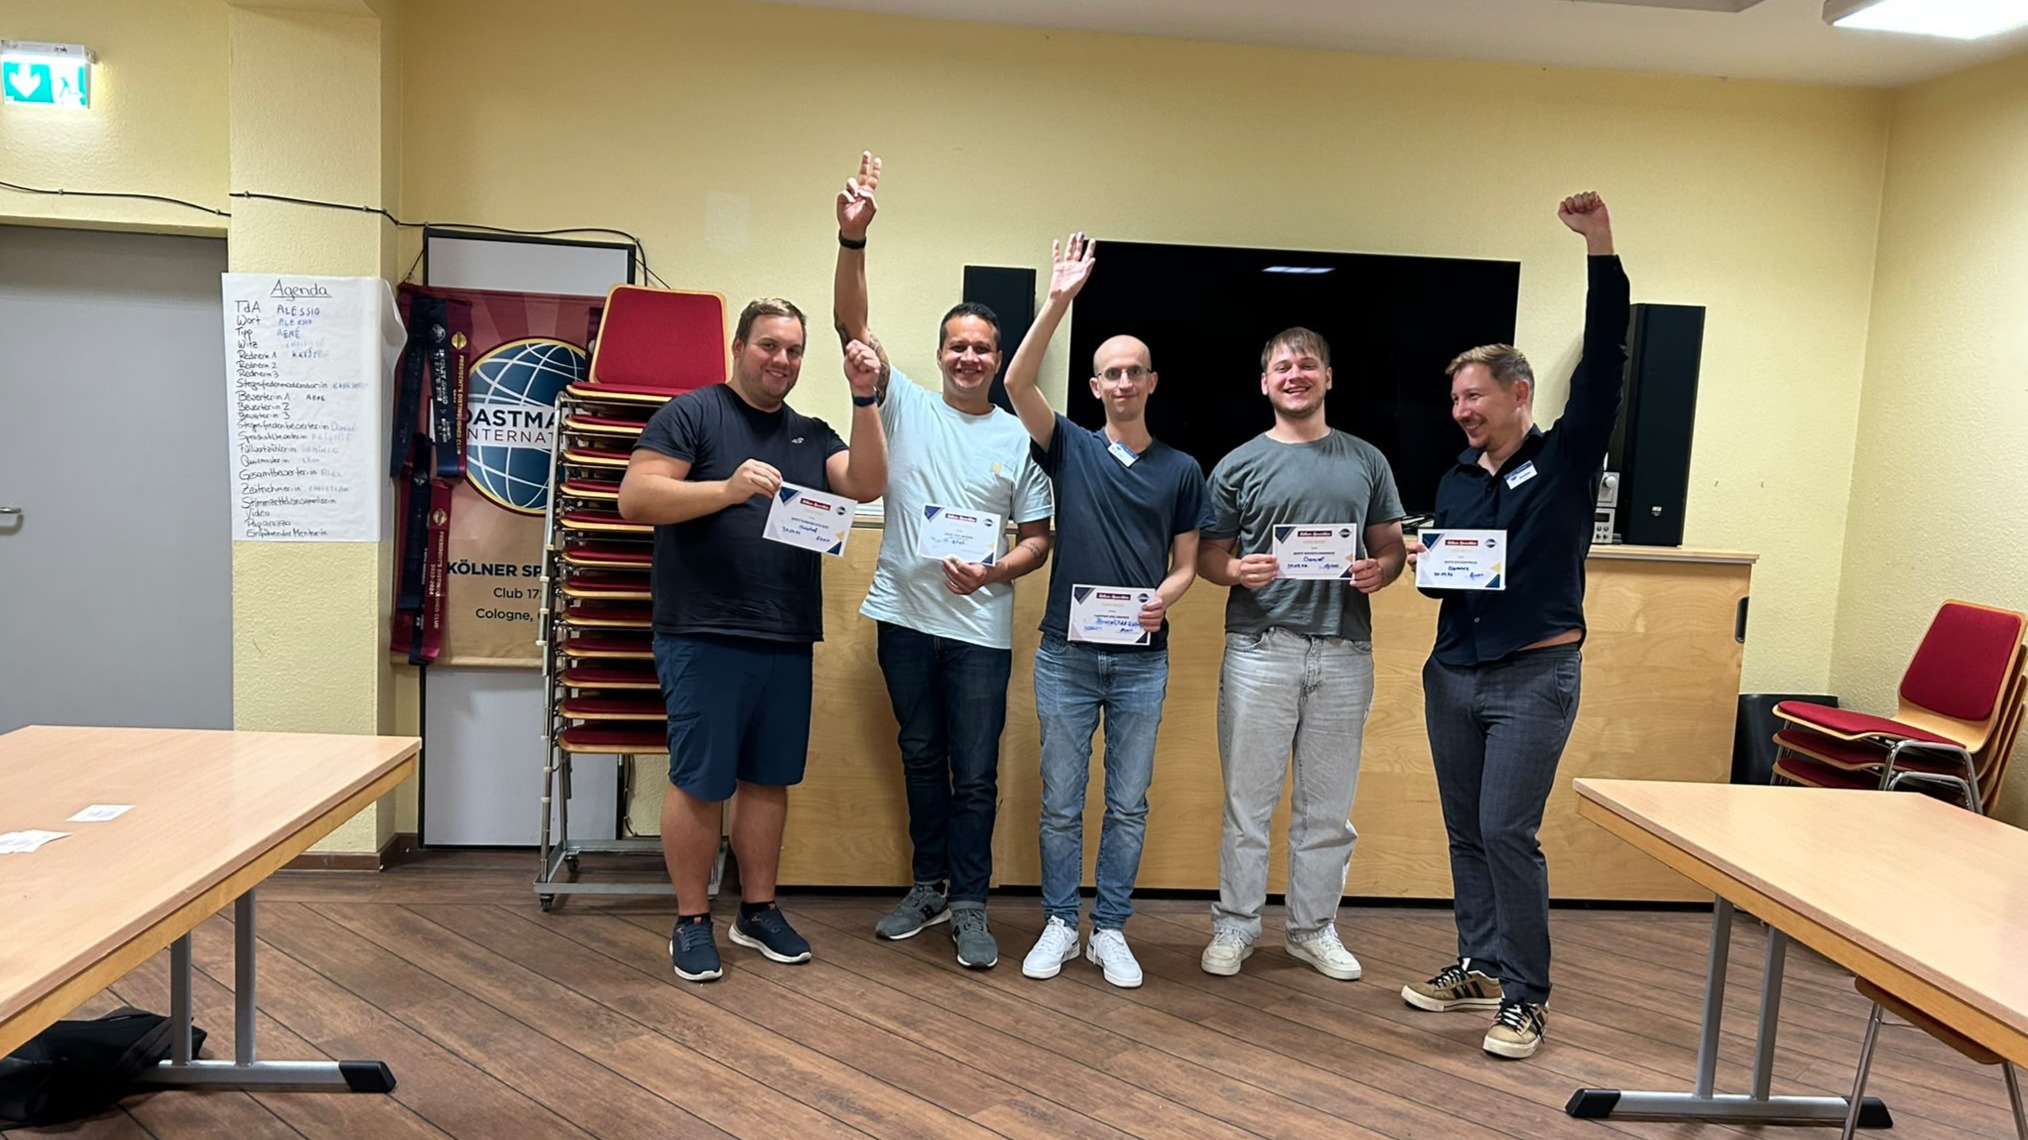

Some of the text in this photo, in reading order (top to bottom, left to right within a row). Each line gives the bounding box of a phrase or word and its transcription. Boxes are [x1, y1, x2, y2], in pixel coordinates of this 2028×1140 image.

[270, 279, 330, 301] Agenda
[276, 304, 320, 316] ALESSIO
[236, 314, 261, 326] Wort
[235, 327, 253, 342] Tipp
[245, 509, 271, 521] Video
[447, 559, 517, 577] KÖLNER
[493, 587, 523, 599] Club
[475, 608, 534, 622] Cologne,
